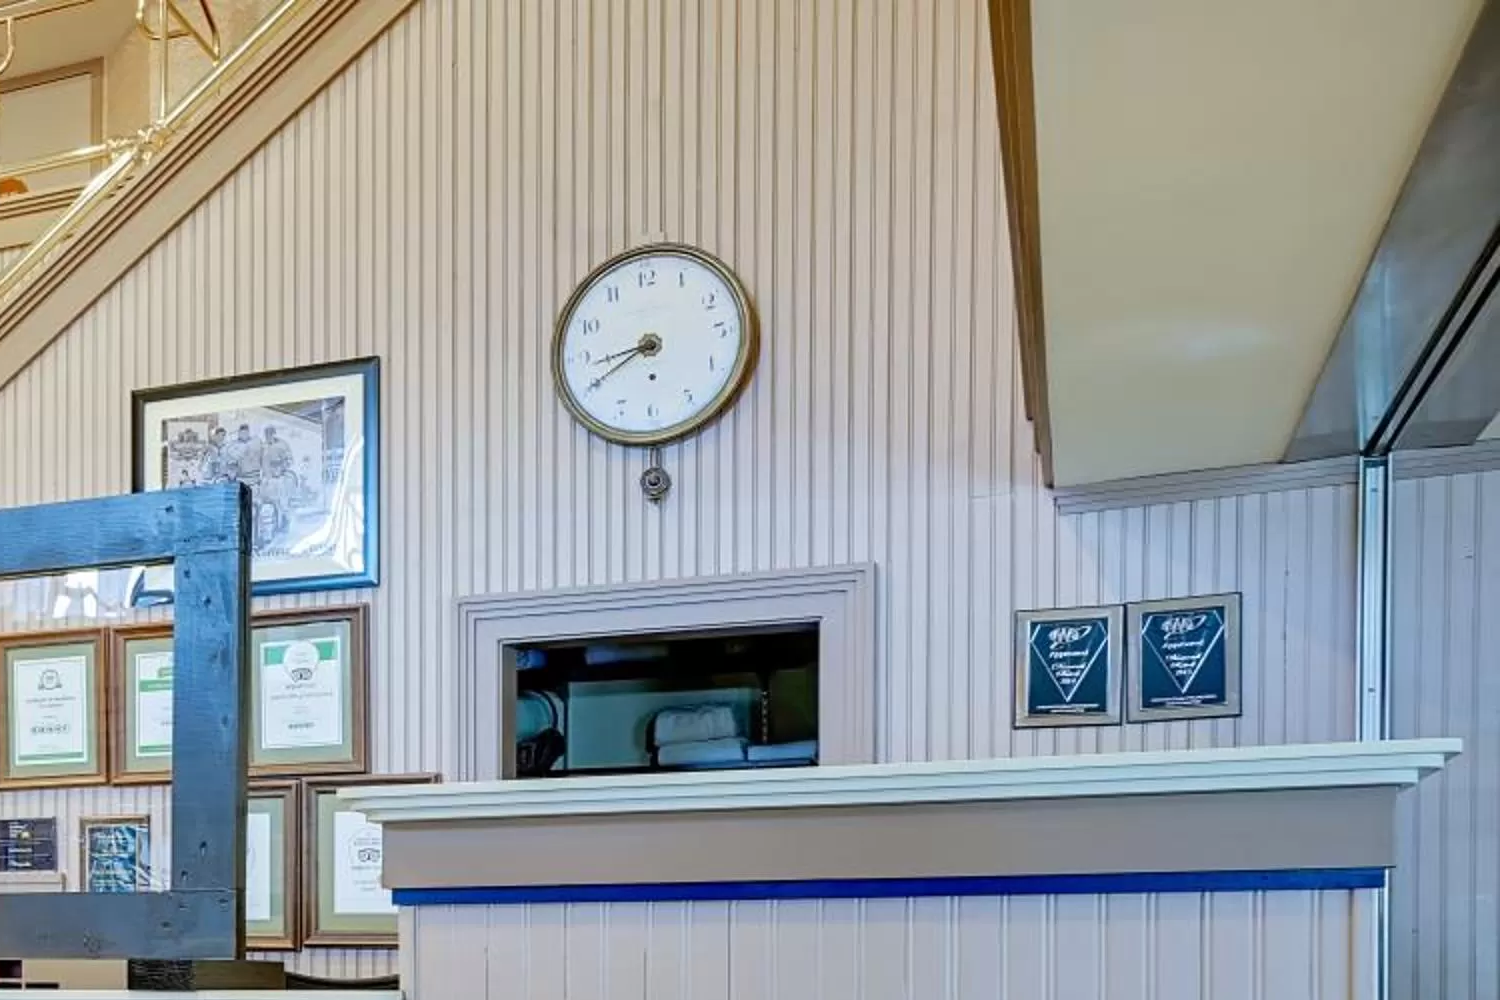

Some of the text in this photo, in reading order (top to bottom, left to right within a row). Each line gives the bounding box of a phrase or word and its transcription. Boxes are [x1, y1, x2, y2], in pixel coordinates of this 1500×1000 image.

[637, 270, 656, 288] 12
[605, 286, 619, 303] 11
[582, 319, 600, 335] 10
